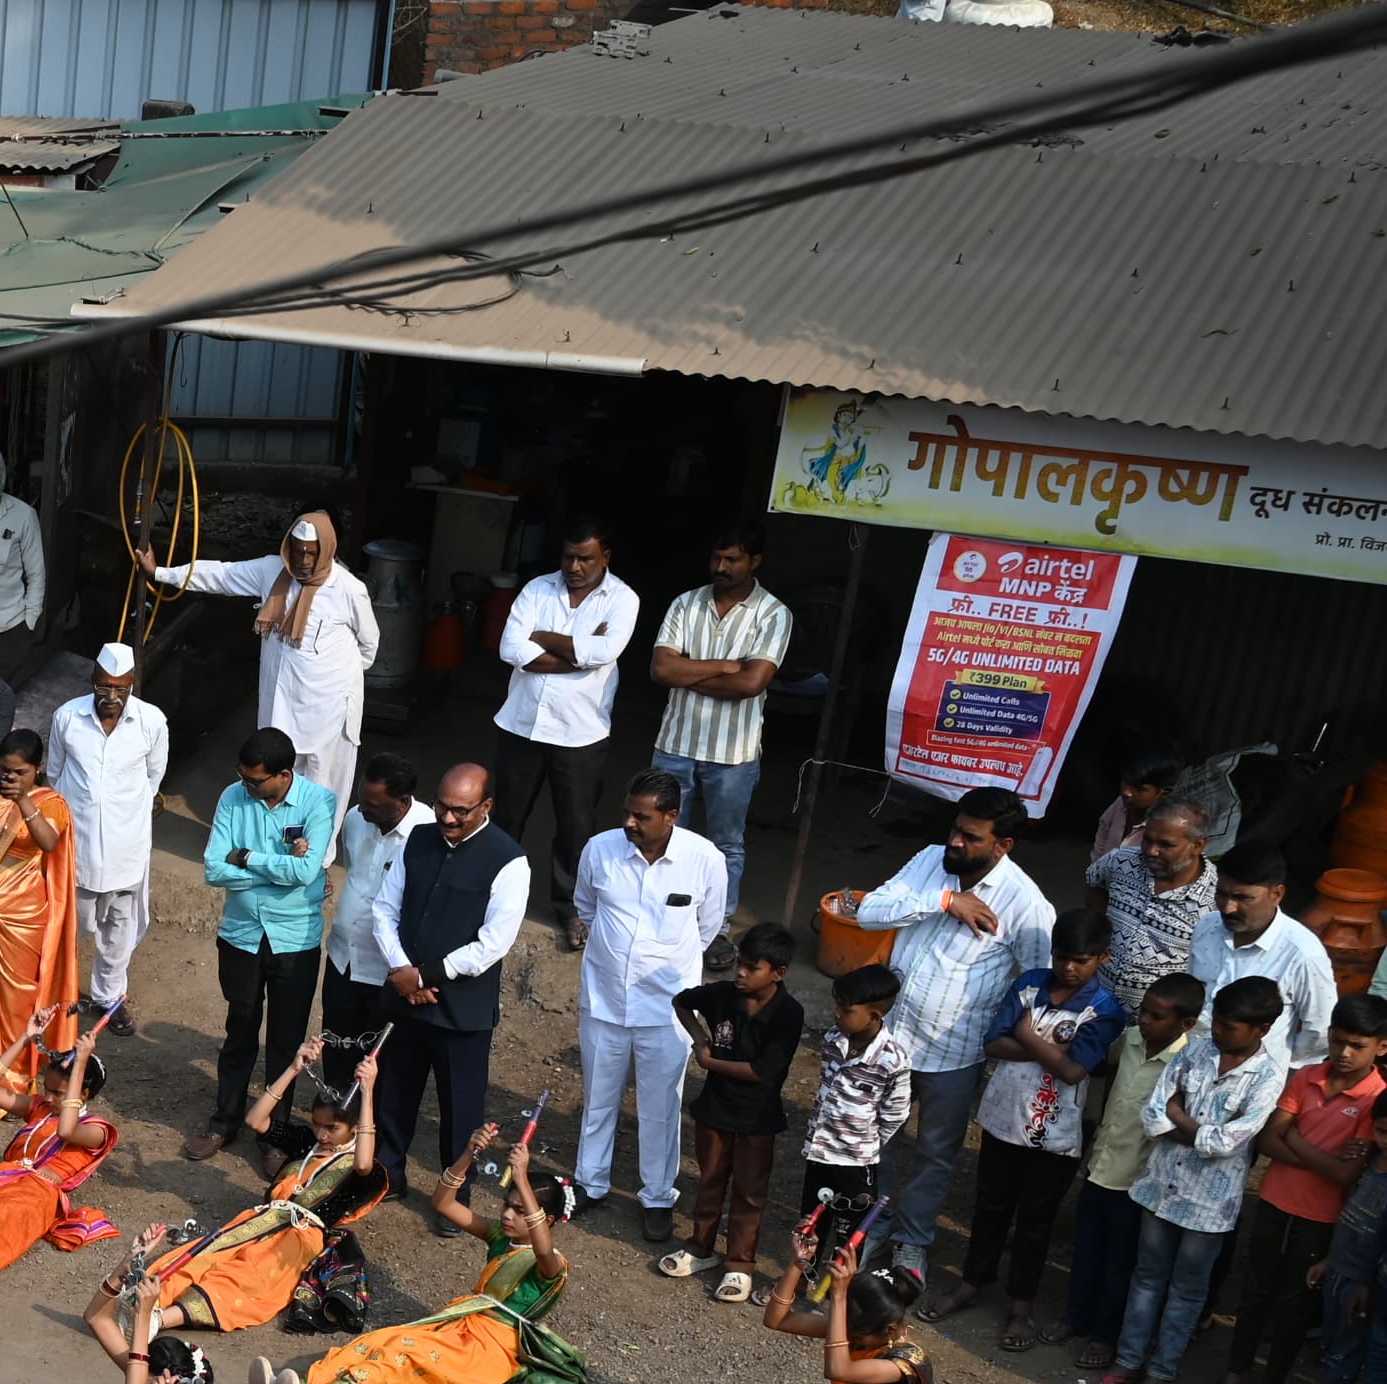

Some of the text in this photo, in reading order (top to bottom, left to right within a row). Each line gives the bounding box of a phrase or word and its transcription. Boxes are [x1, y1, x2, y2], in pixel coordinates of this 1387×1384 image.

[907, 415, 1250, 535] गोपालकृष्ण
[1249, 486, 1296, 519] दूध
[1315, 531, 1387, 552] प्रो. प्रा. विज
[1025, 555, 1095, 580] airtel
[999, 577, 1088, 604] MNP केंद्र
[988, 602, 1038, 622] FREE
[958, 618, 983, 632] आपला
[1035, 629, 1054, 641] नंबर
[1064, 634, 1093, 646] बदलता
[937, 631, 961, 643] Airtel
[980, 636, 994, 648] पोर्ट
[994, 640, 1011, 650] करा
[1012, 641, 1032, 654] आणि
[1032, 643, 1055, 655] सोबत
[927, 647, 1081, 676] 5G/4G UNLIMITED DATA
[969, 671, 1027, 689] ₹399 Plan
[962, 690, 1020, 706] Unlimited Calls
[960, 706, 996, 718] Unlimited
[997, 710, 1015, 720] Data
[955, 720, 1014, 735] 28 Days Validity
[931, 734, 953, 745] Blazing
[953, 736, 966, 745] fast
[987, 741, 1015, 750] unlimited
